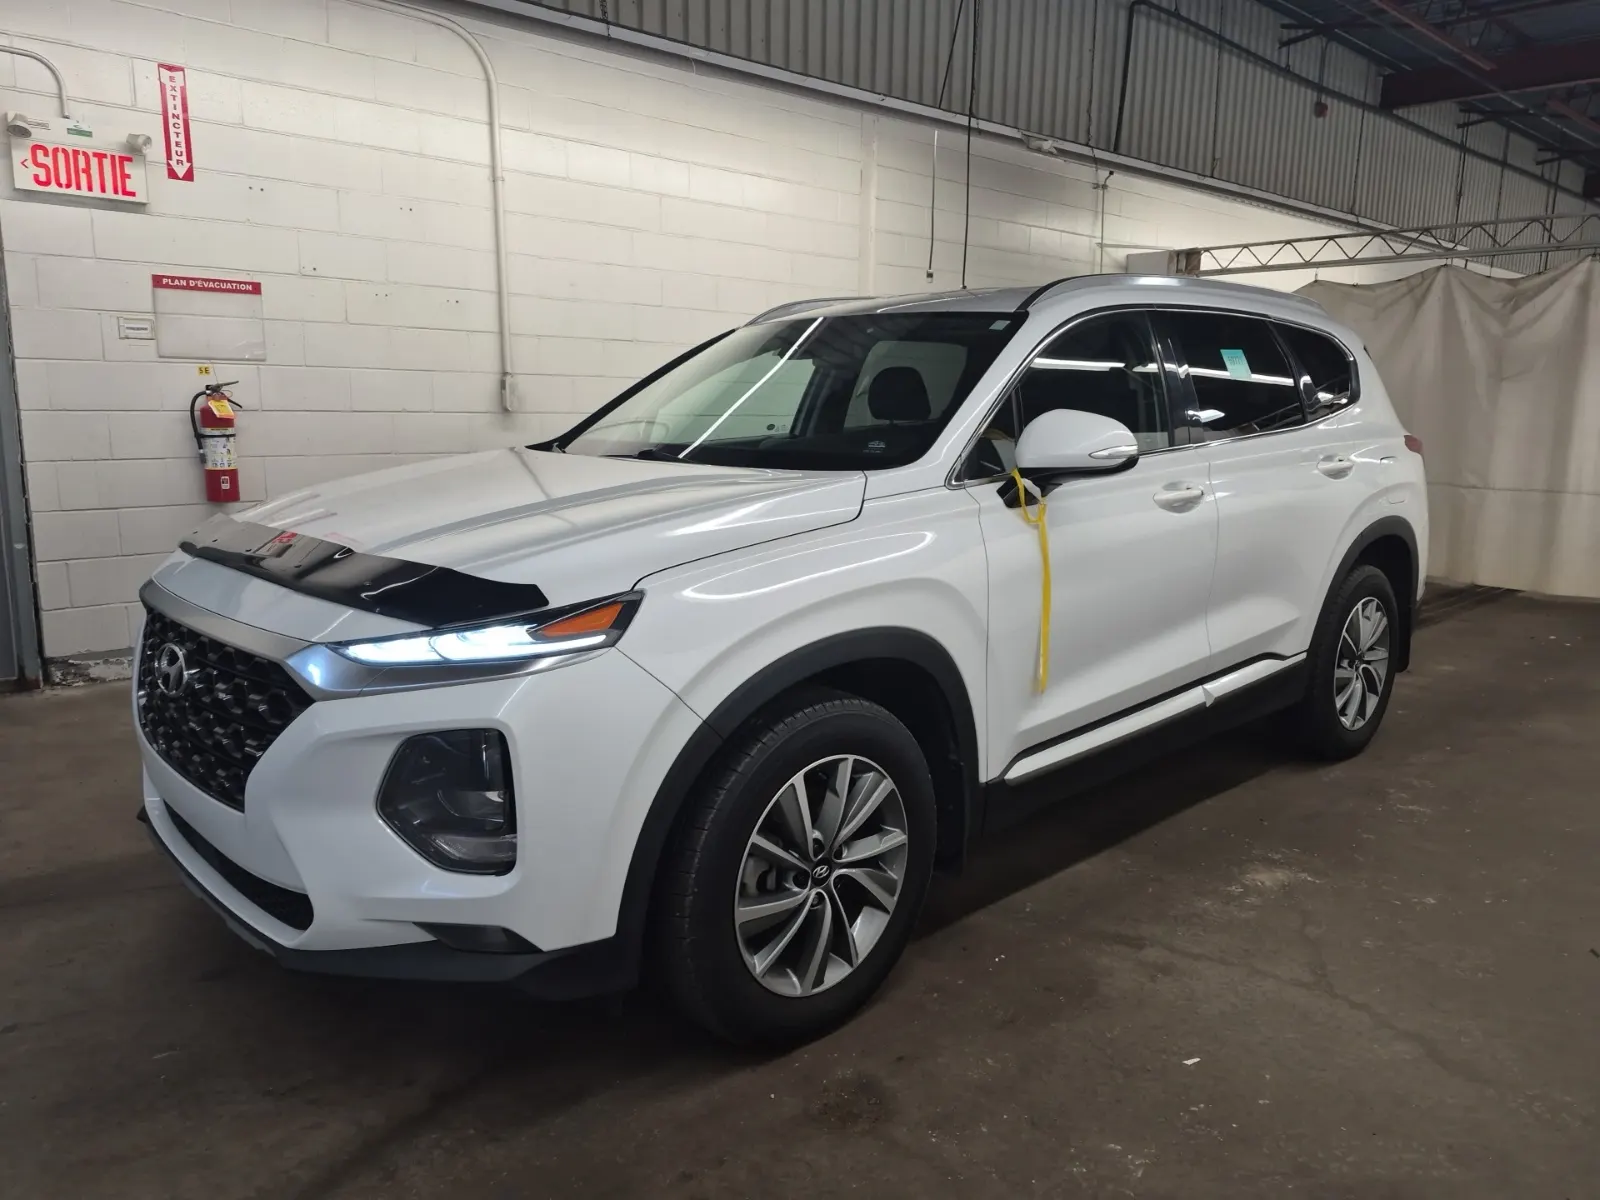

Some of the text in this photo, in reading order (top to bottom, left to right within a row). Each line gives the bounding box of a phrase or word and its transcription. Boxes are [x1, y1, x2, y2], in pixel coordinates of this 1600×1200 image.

[169, 75, 184, 166] EXTINCTEUR
[30, 144, 136, 198] SORTIE
[162, 278, 252, 291] PLAN D'ÉVACUATION
